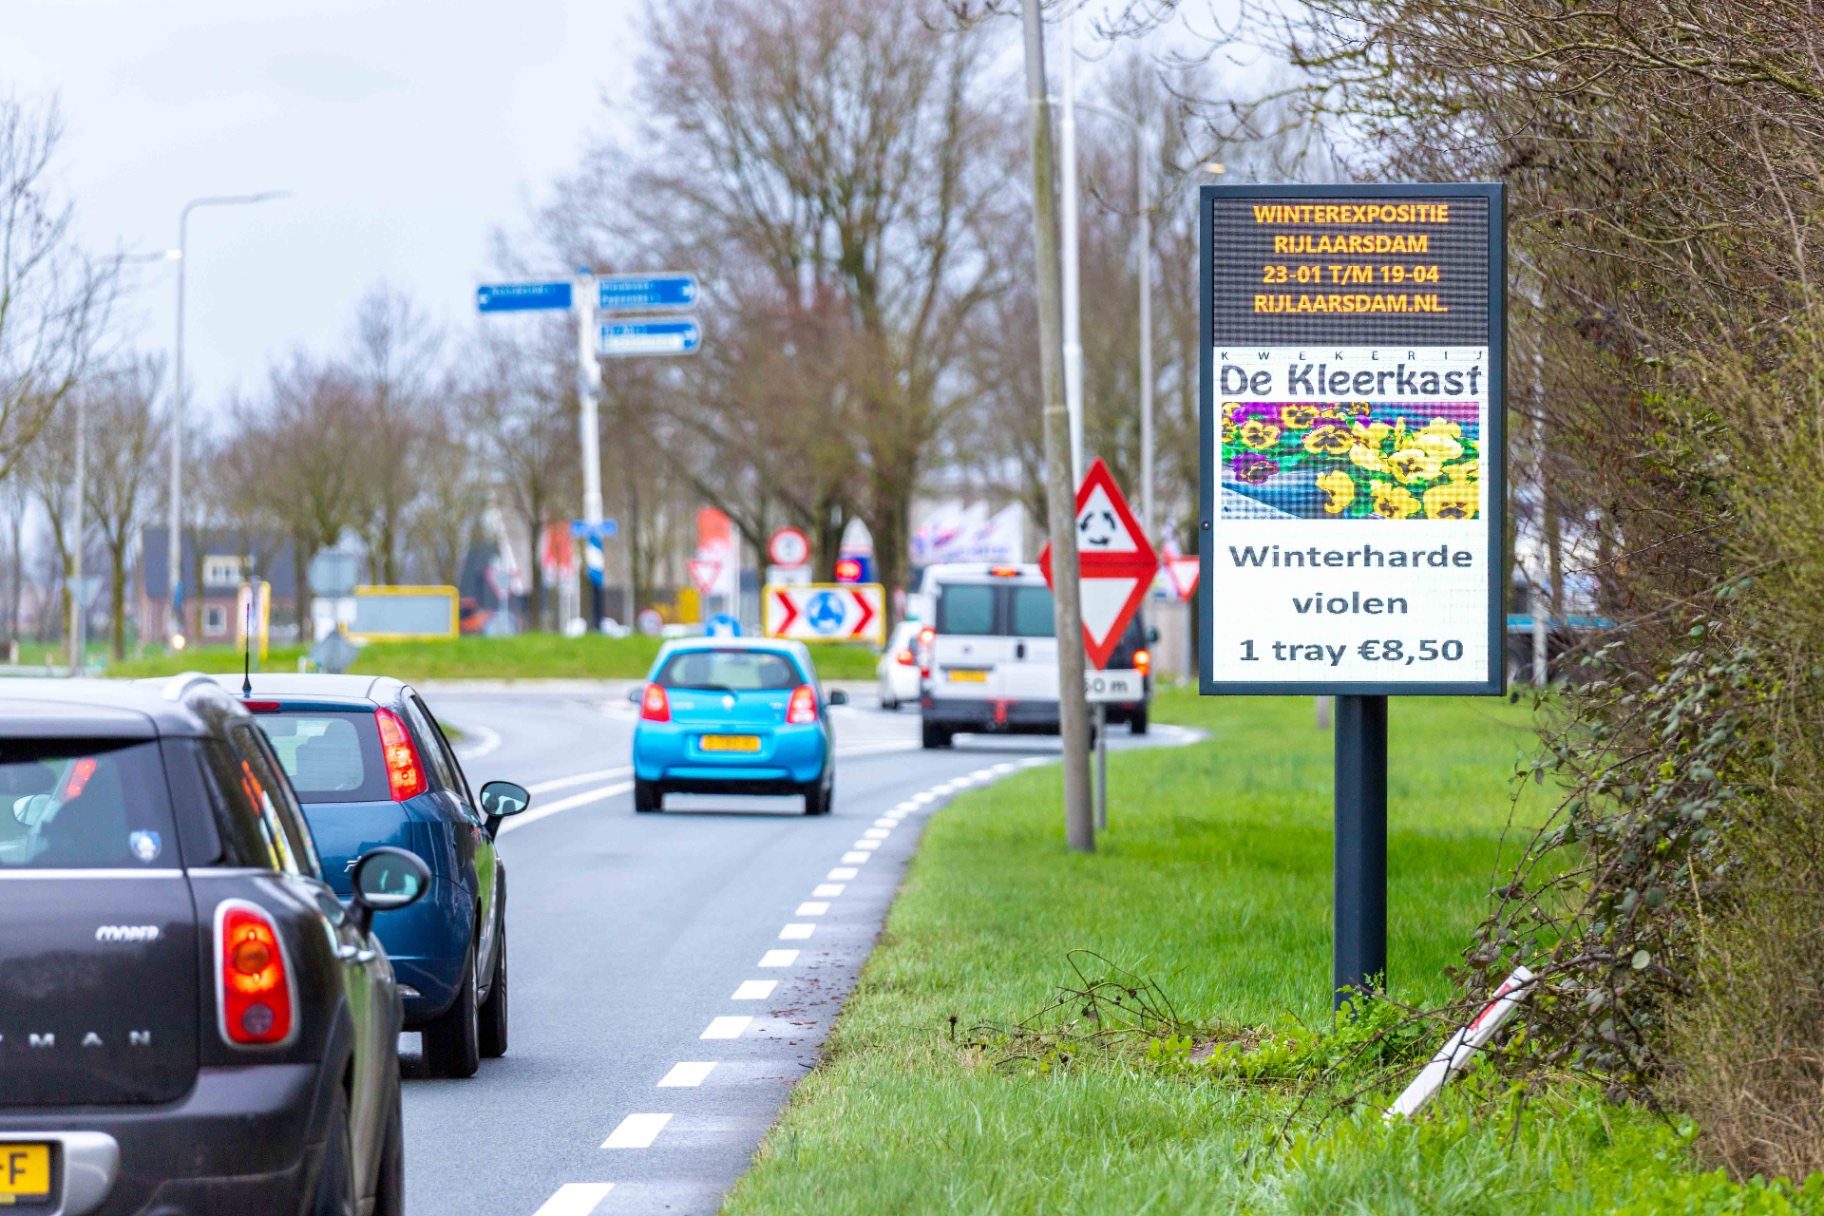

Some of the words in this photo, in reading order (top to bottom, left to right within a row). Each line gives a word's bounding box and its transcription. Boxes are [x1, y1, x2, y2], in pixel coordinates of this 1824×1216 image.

[1253, 204, 1449, 223] WINTEREXPOSITIE
[1274, 235, 1428, 253] RIJLAARSDAM
[1263, 265, 1320, 283] 23-01
[1328, 265, 1373, 284] T/M
[1380, 265, 1440, 283] 19-04
[1254, 294, 1448, 312] RIJLAARSDAM.NL.
[1221, 366, 1271, 395] De
[1289, 364, 1481, 395] Kleerkast
[1230, 545, 1472, 567] Winterharde
[1293, 592, 1407, 614] violen
[1241, 640, 1258, 660] 1
[1272, 642, 1346, 666] tray
[1358, 640, 1463, 665] €8,50
